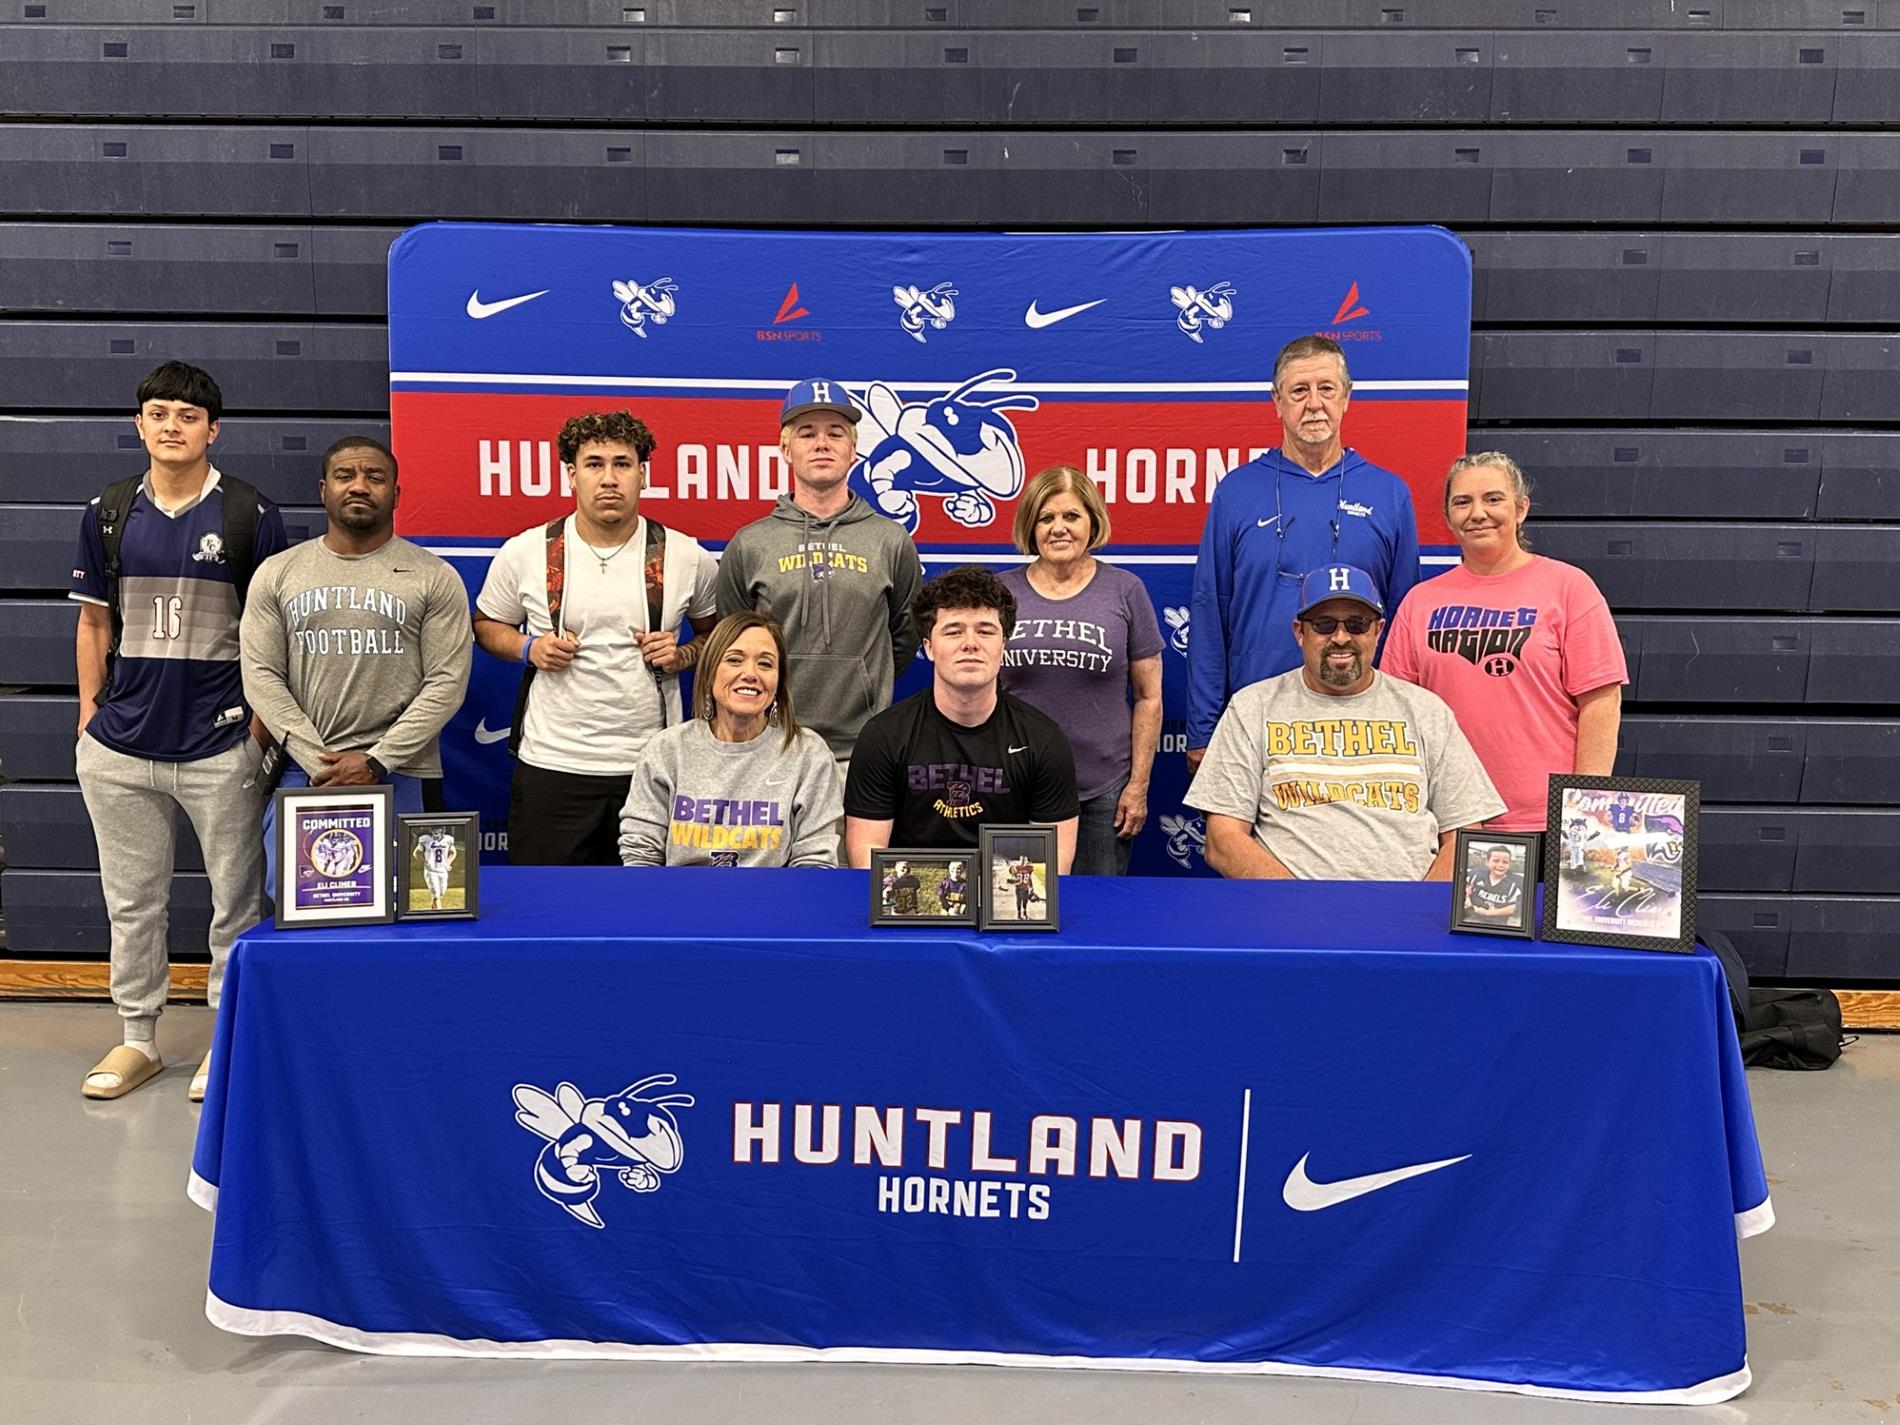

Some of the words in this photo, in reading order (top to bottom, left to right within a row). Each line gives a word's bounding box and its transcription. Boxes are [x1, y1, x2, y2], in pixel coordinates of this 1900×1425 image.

[811, 382, 833, 403] H
[479, 439, 794, 501] HULAND
[1086, 448, 1271, 504] HORN
[1328, 567, 1351, 591] H
[152, 595, 183, 640] 16
[288, 585, 406, 627] HUNTLAND
[295, 628, 405, 655] FOOTBALL
[1008, 619, 1113, 656] ETHEL
[1000, 648, 1113, 672] NIVERSITY
[1265, 719, 1417, 758] BETHEL
[907, 763, 1012, 794] BETHEL
[672, 794, 785, 827] BETHEL
[1271, 780, 1421, 814] WILDCATS
[302, 817, 371, 830] COMMITTED
[670, 822, 785, 850] WILDCATS
[434, 848, 443, 864] 8
[1477, 888, 1508, 904] REBELS
[733, 1102, 1202, 1182] HUNTLAND
[878, 1176, 1051, 1220] HORNETS
